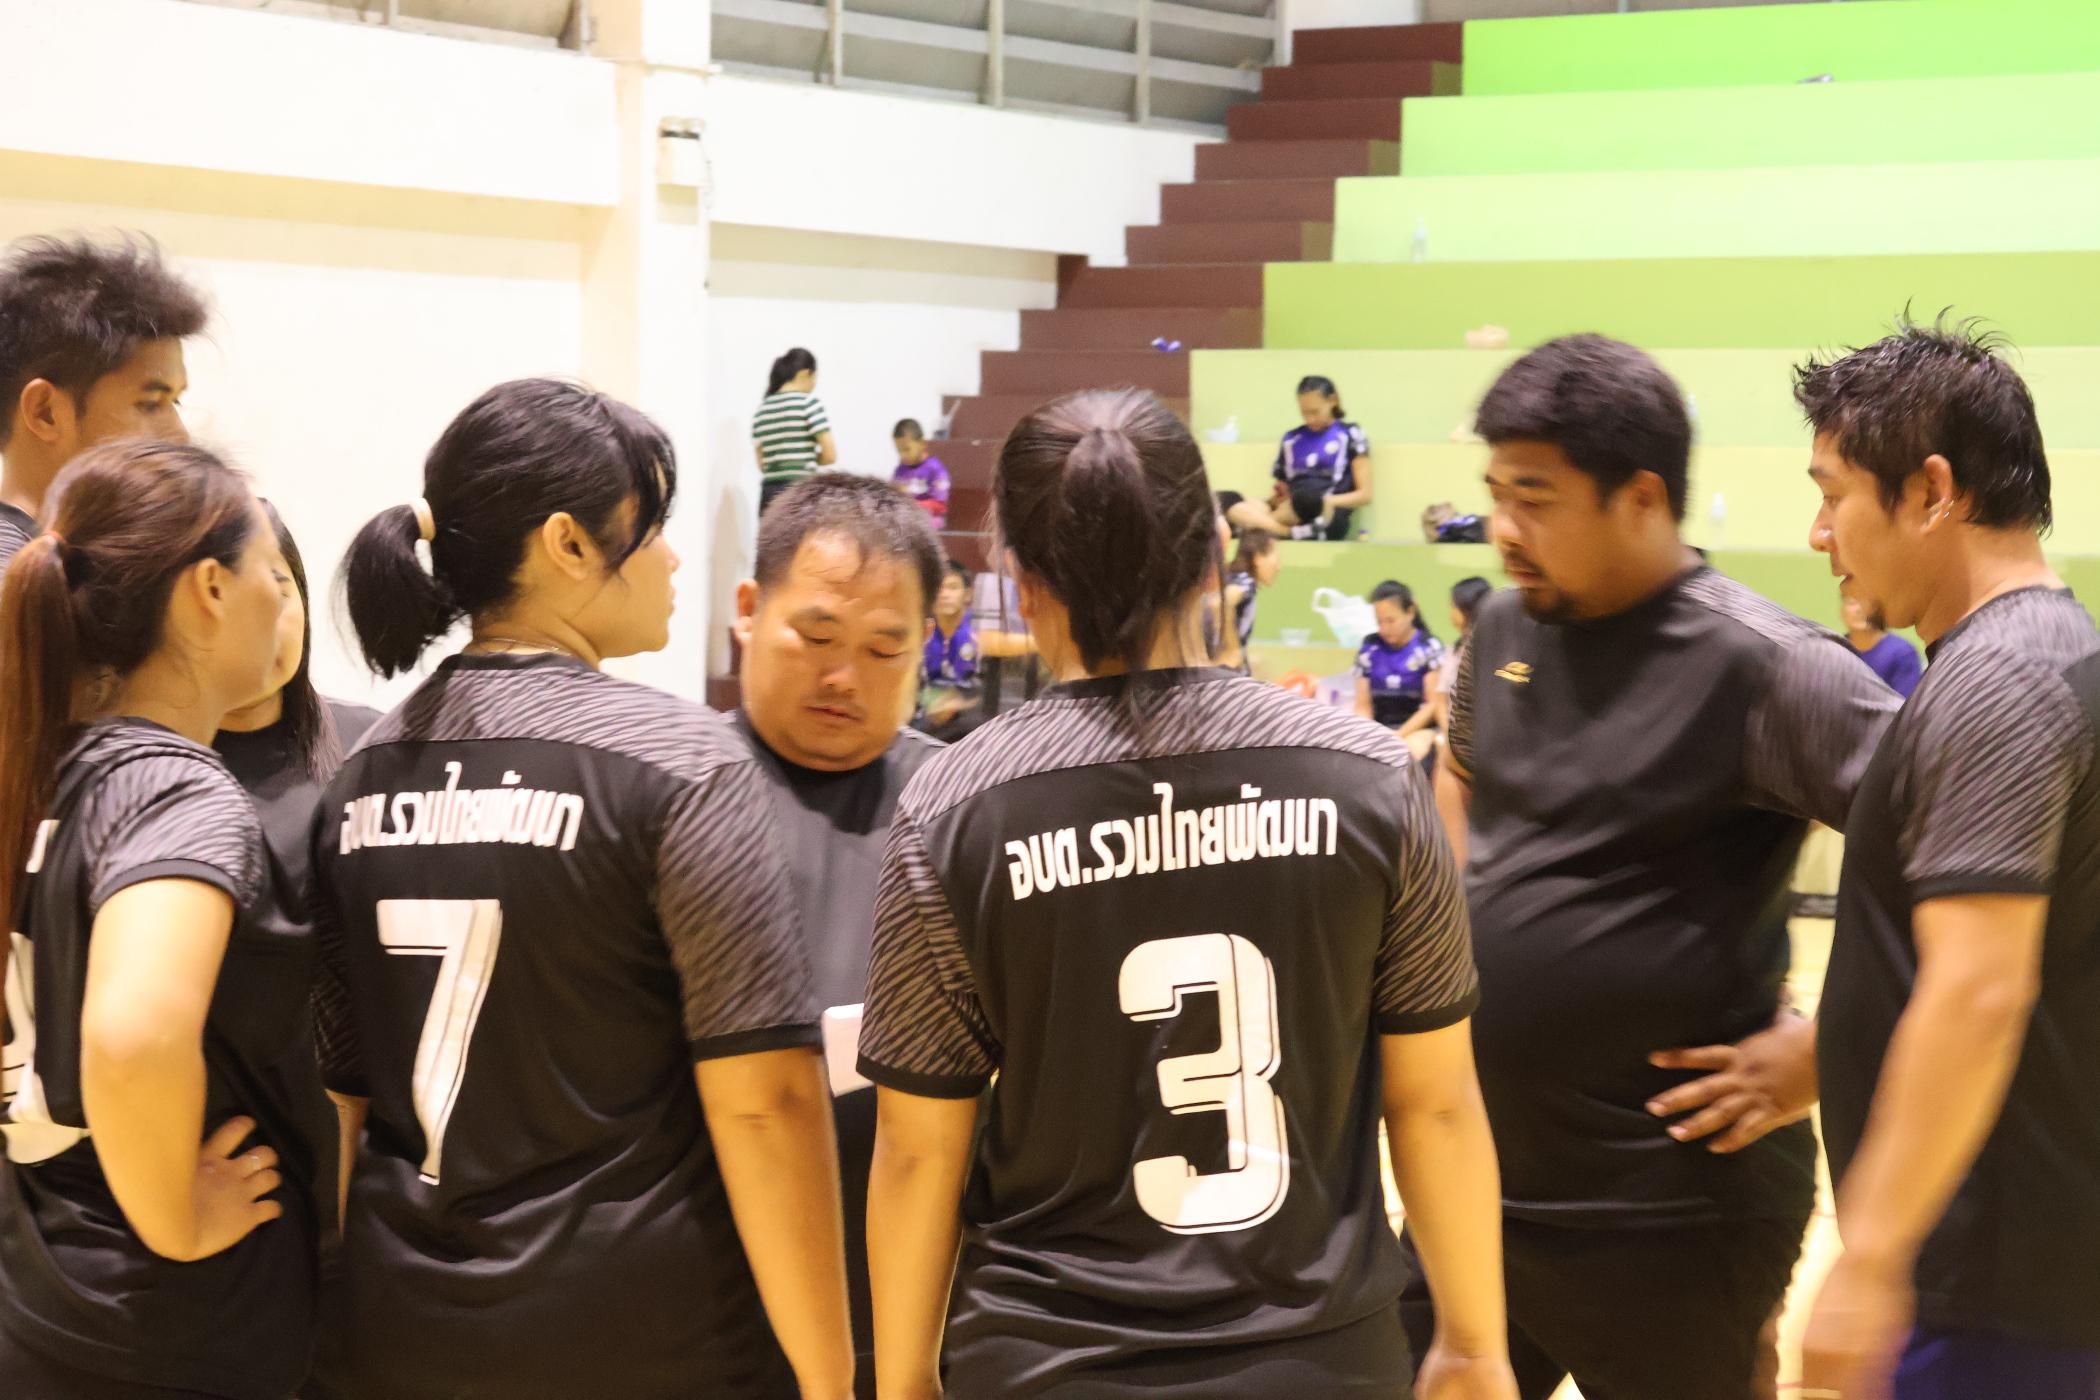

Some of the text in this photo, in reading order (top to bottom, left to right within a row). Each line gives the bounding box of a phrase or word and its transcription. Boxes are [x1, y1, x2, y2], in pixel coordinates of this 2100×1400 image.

[1005, 782, 1337, 900] อบต.รวมไทยพัฒนา
[377, 899, 502, 1185] 7
[1119, 933, 1290, 1235] 3
